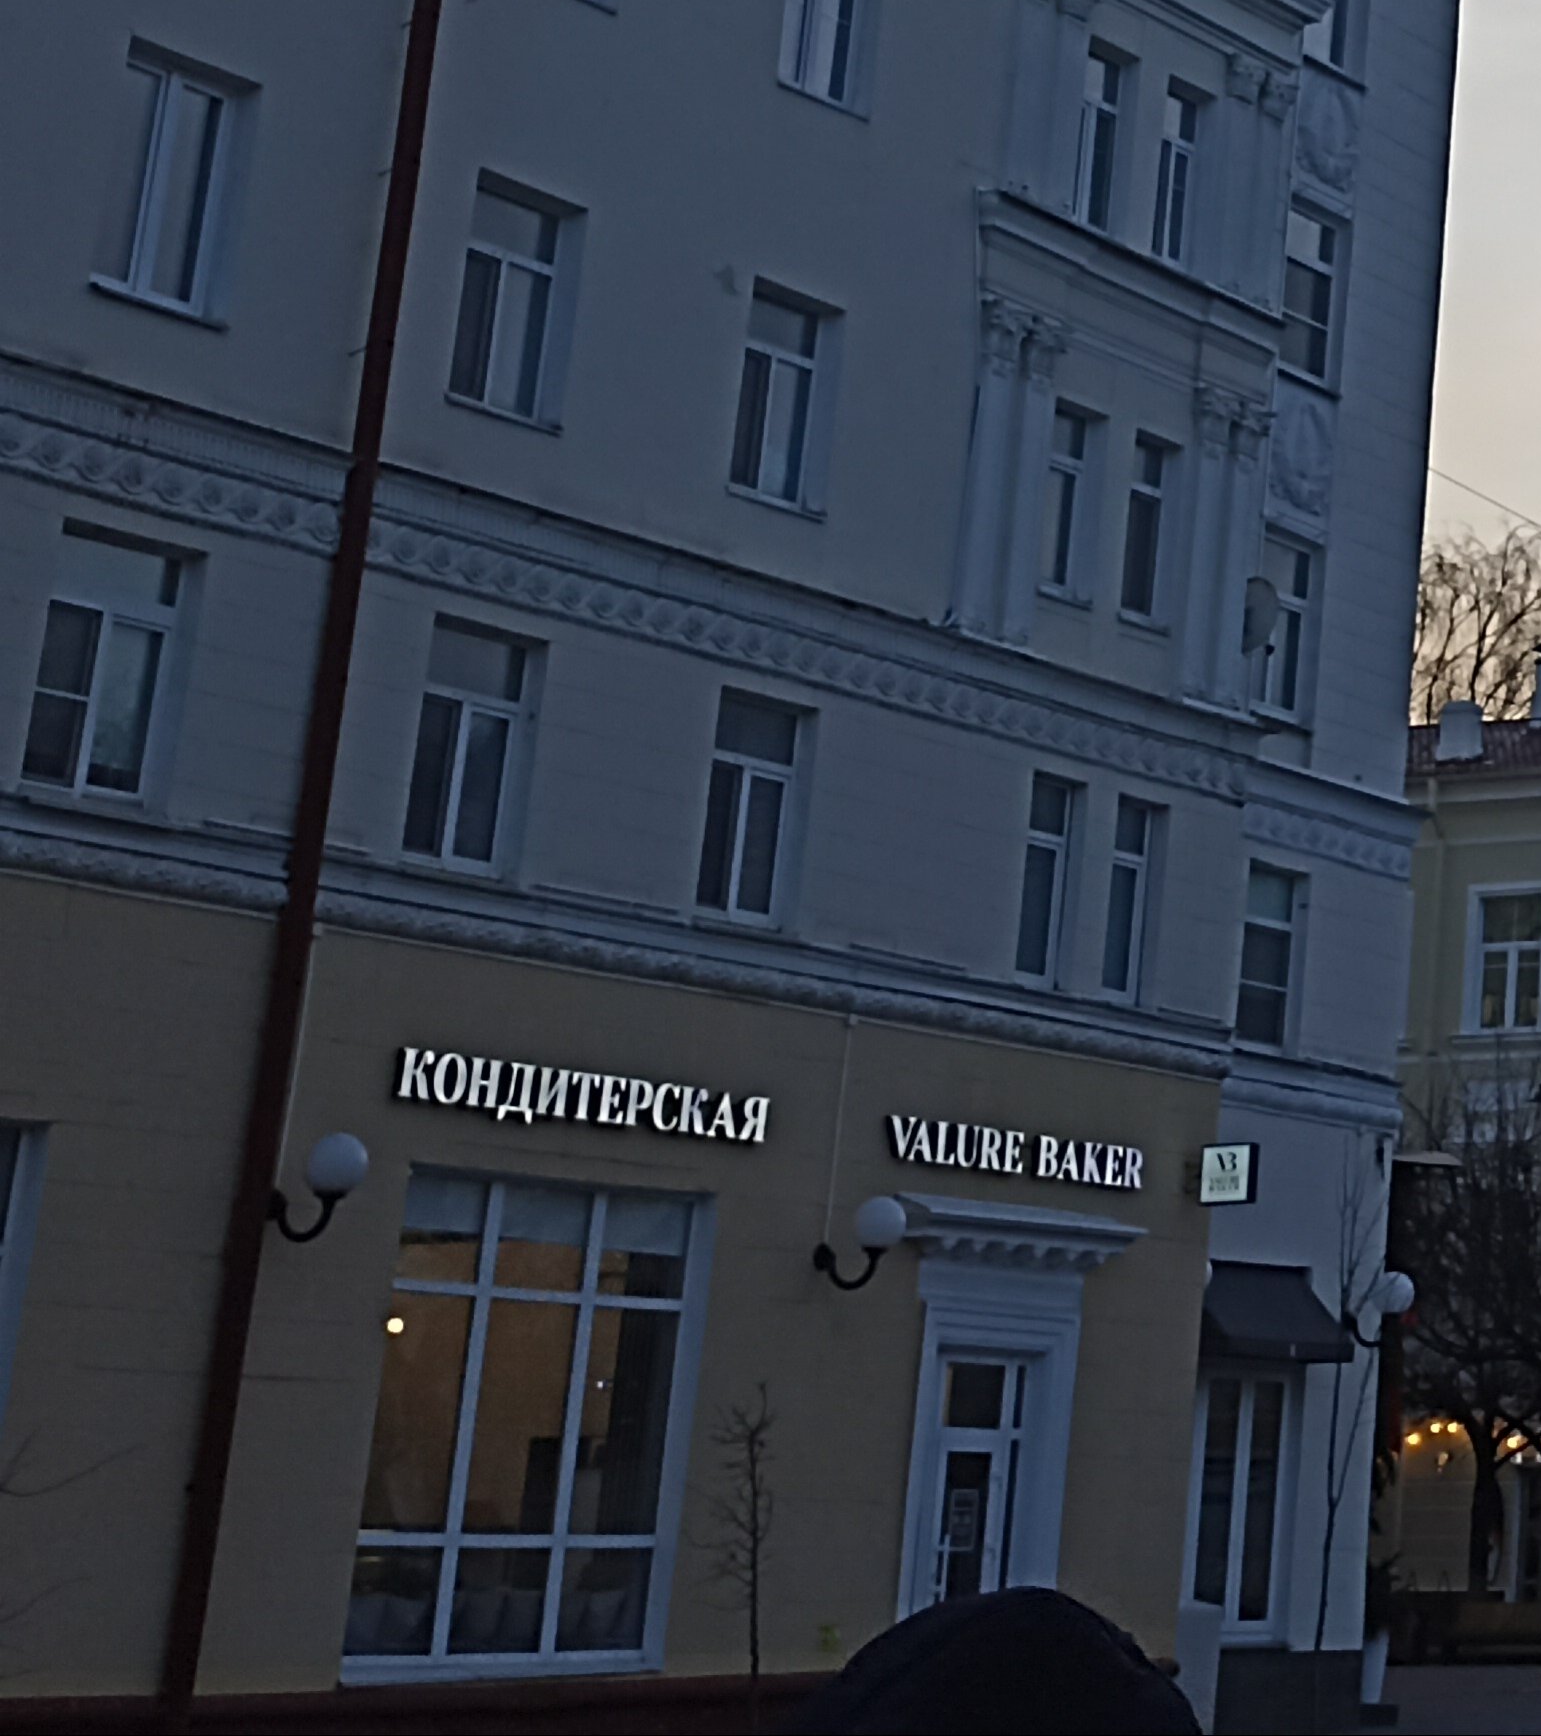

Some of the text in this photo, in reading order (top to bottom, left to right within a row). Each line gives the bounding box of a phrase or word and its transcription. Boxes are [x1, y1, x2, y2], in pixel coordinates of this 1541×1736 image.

[397, 1045, 771, 1144] КОНДИТЕРСКАЯ
[891, 1114, 1144, 1190] VALURE BAKER
